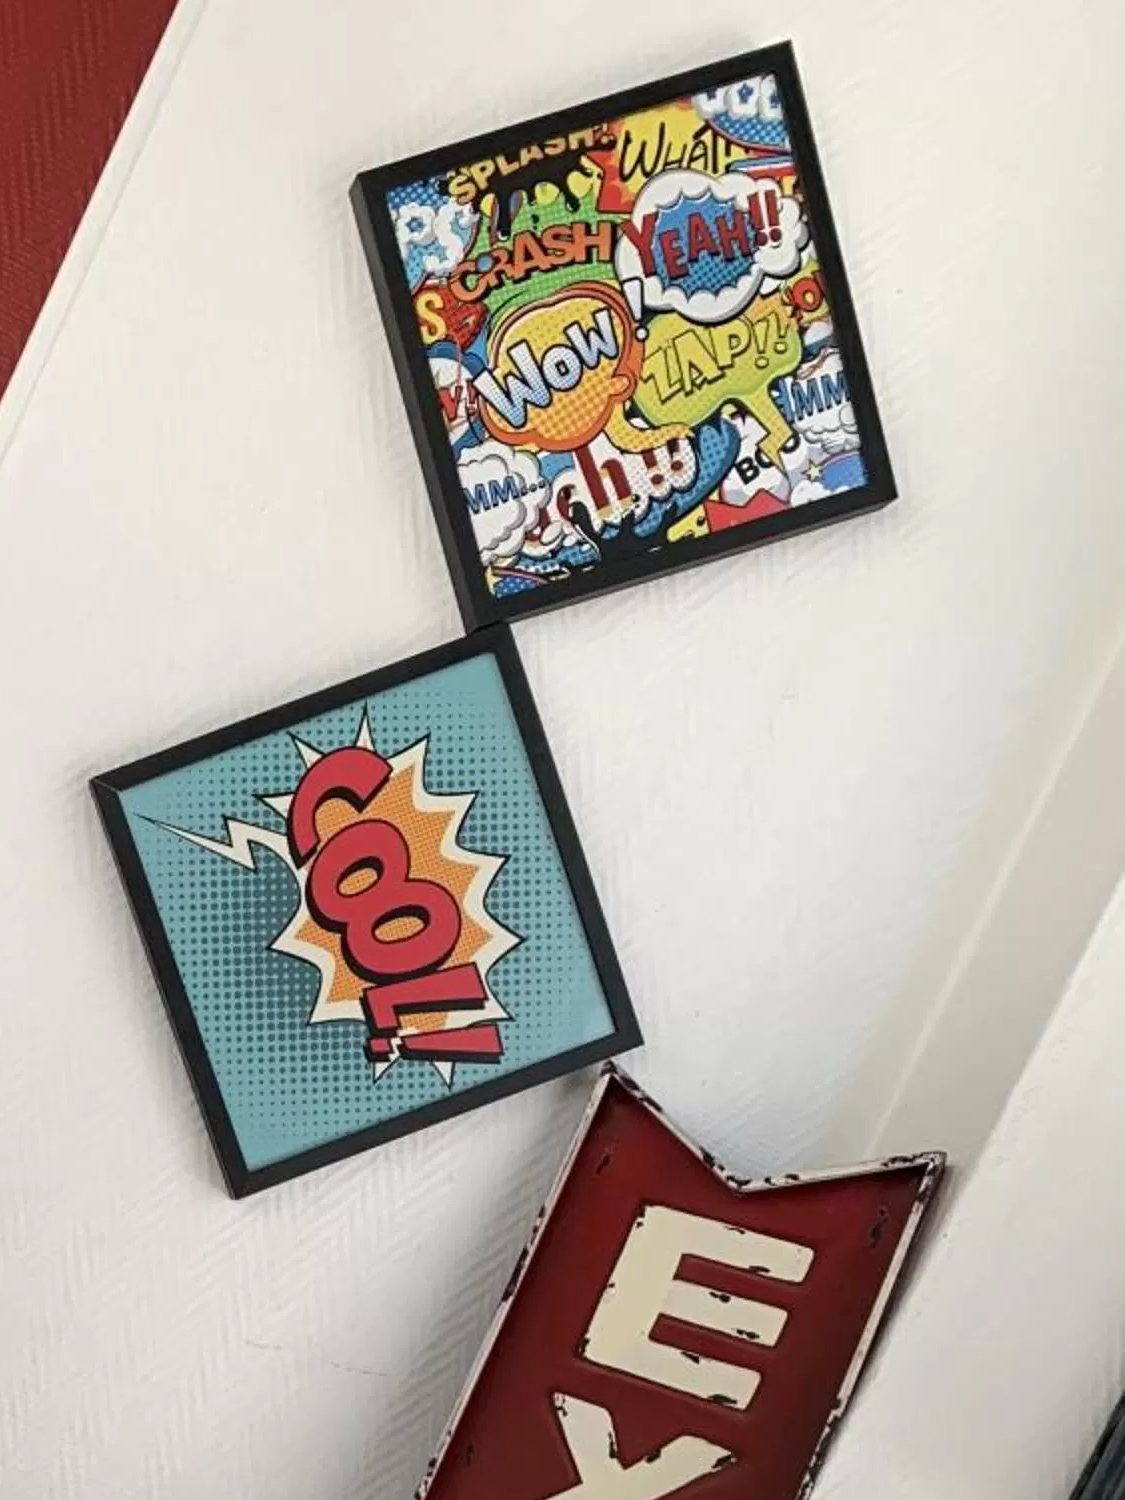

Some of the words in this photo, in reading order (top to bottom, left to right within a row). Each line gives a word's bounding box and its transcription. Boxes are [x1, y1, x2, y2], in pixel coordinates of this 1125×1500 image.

[449, 221, 617, 301] CRASH
[619, 190, 781, 277] YEAH!!
[287, 745, 505, 1063] COOL!
